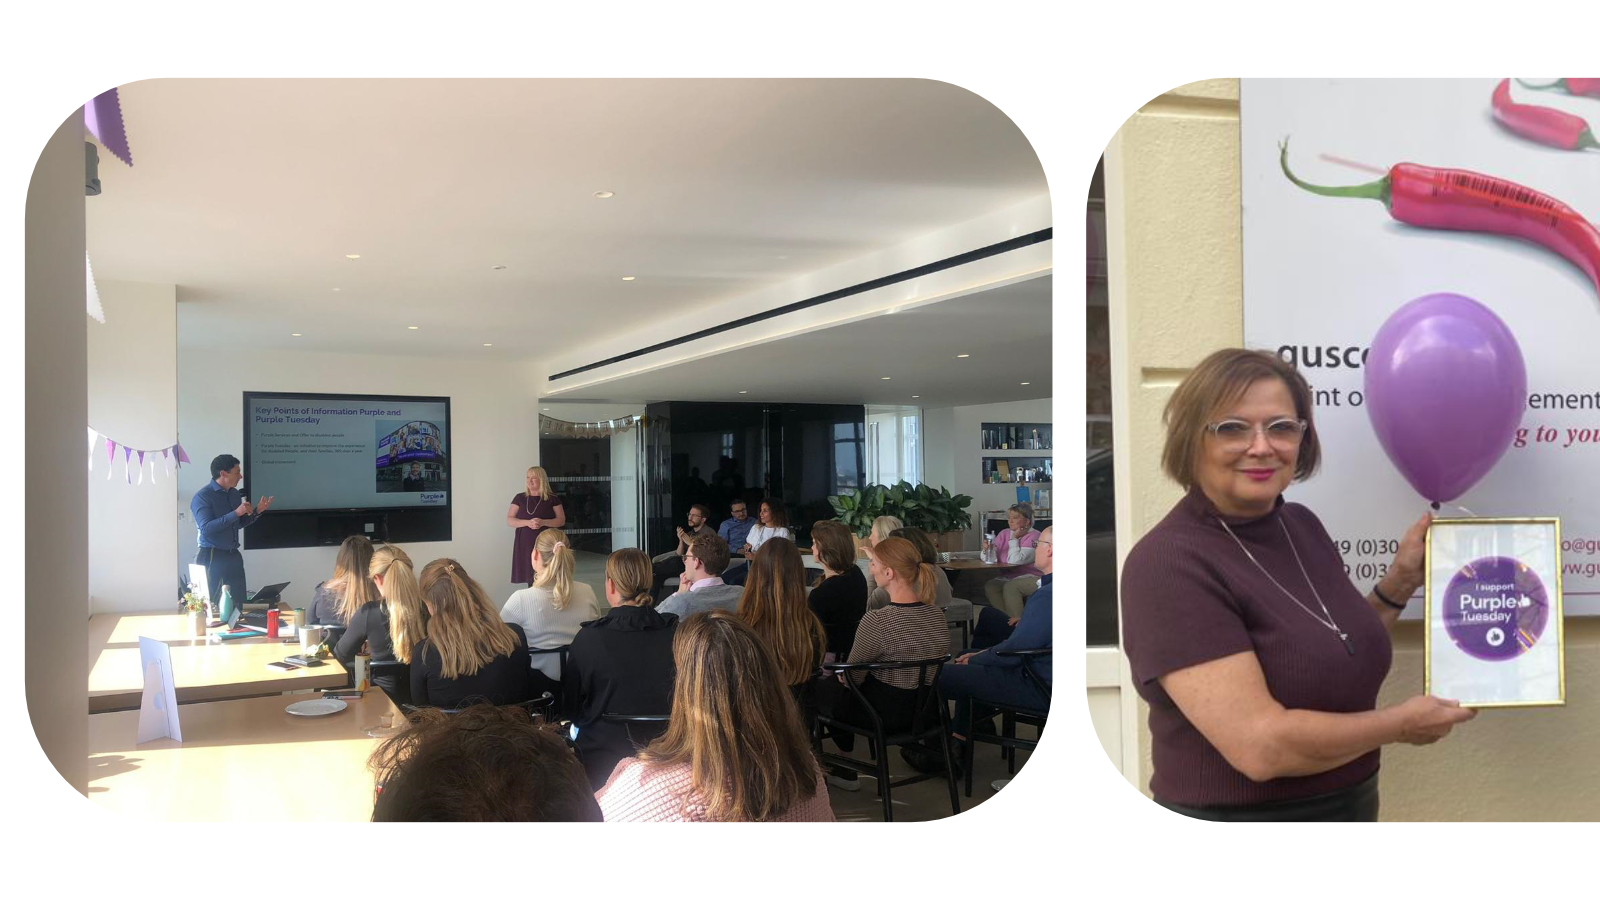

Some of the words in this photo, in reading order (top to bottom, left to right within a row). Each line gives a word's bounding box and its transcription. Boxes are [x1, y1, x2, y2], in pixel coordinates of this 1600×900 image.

[1278, 345, 1371, 370] gusc
[255, 406, 271, 415] Key
[360, 408, 385, 417] Purple
[256, 416, 283, 424] Purple
[286, 416, 320, 426] Tuesday
[1536, 424, 1558, 443] to
[1356, 539, 1399, 557] (0)30
[1480, 584, 1514, 592] support
[1460, 594, 1516, 612] Purple
[1460, 611, 1512, 624] Tuesday
